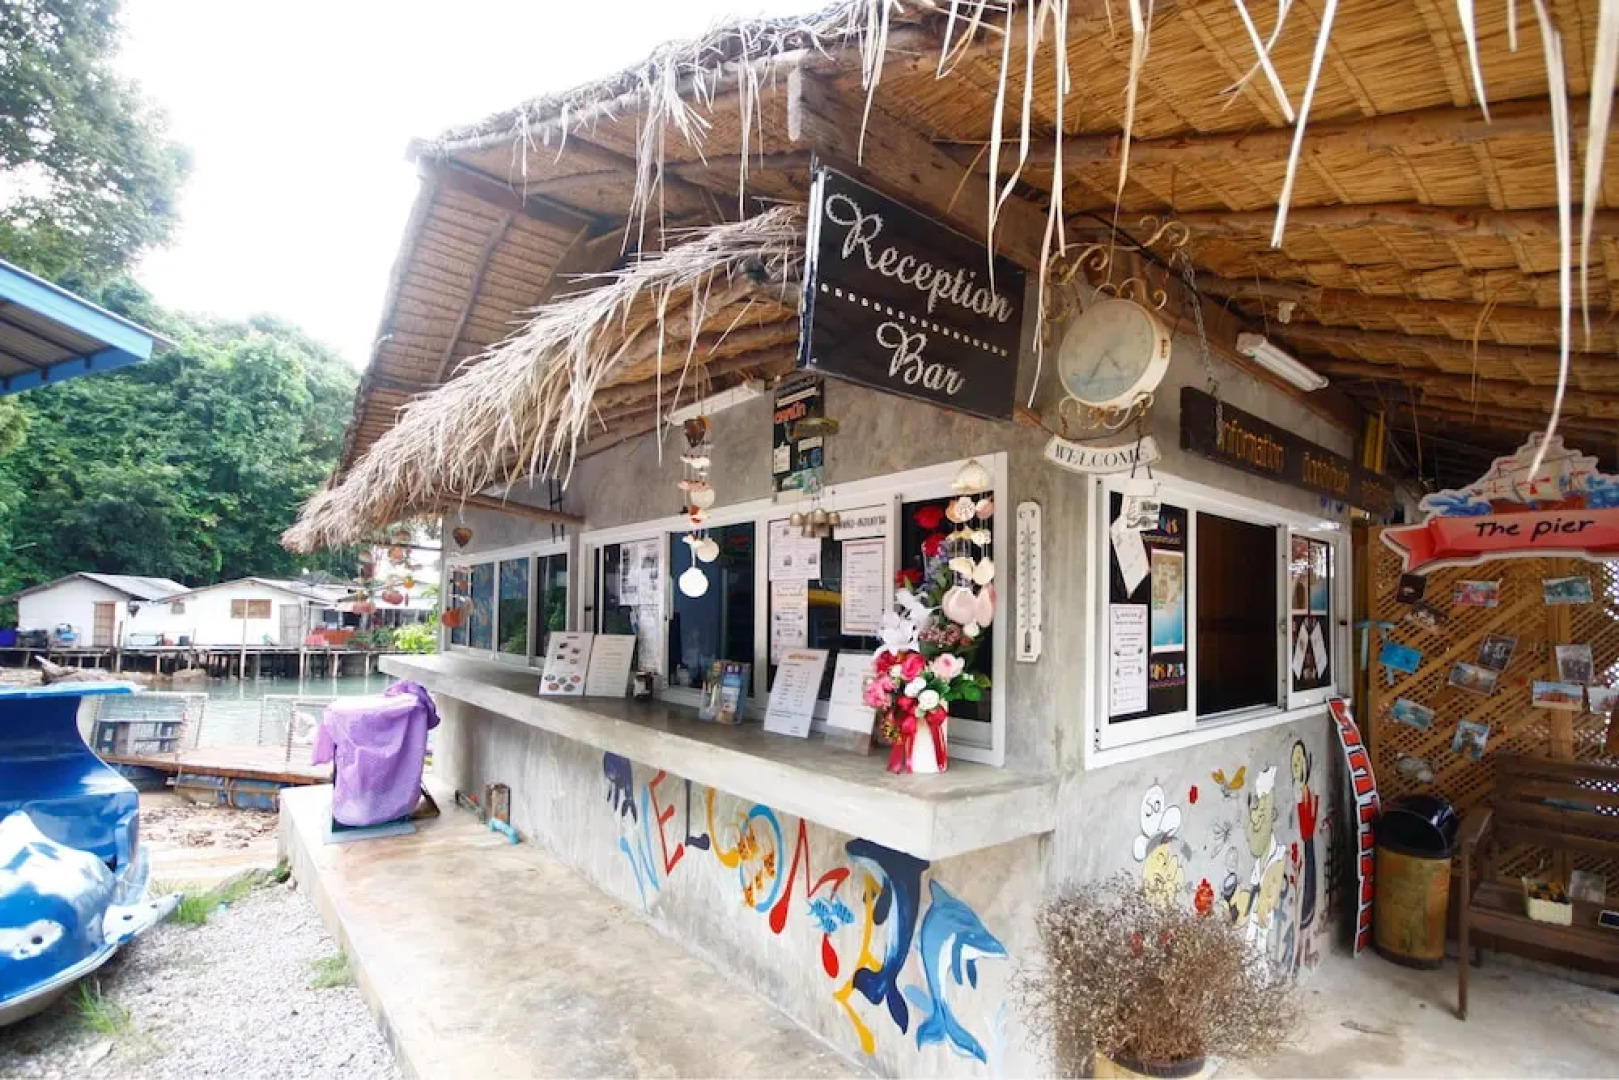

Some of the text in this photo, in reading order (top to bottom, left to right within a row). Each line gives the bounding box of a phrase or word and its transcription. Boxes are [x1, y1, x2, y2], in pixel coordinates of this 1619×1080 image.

[825, 193, 1014, 322] Reception
[876, 321, 966, 395] Bar
[1475, 517, 1595, 543] The pier
